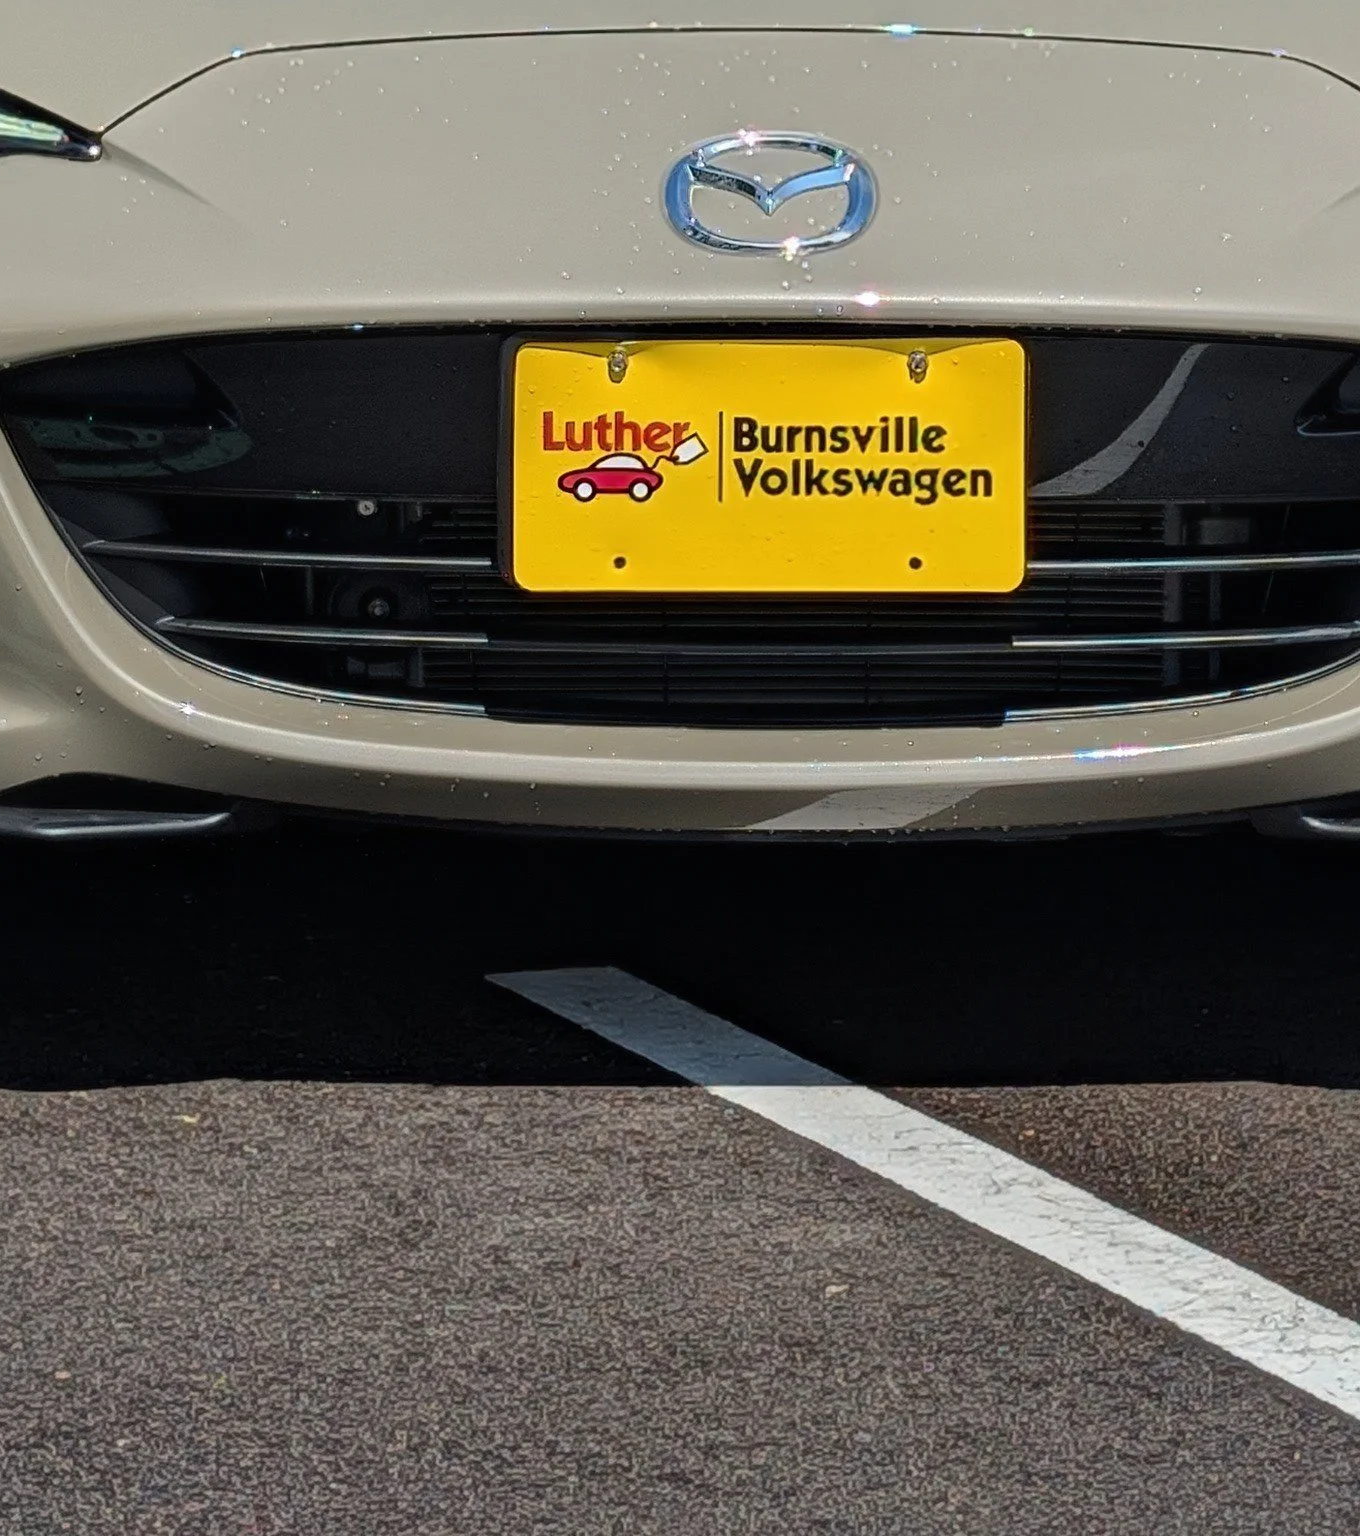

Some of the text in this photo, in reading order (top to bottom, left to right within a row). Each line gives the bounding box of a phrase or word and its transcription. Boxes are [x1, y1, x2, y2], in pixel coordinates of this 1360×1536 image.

[542, 410, 690, 452] Luther
[733, 416, 947, 454] Burnsville
[733, 458, 993, 505] Volkswagen
